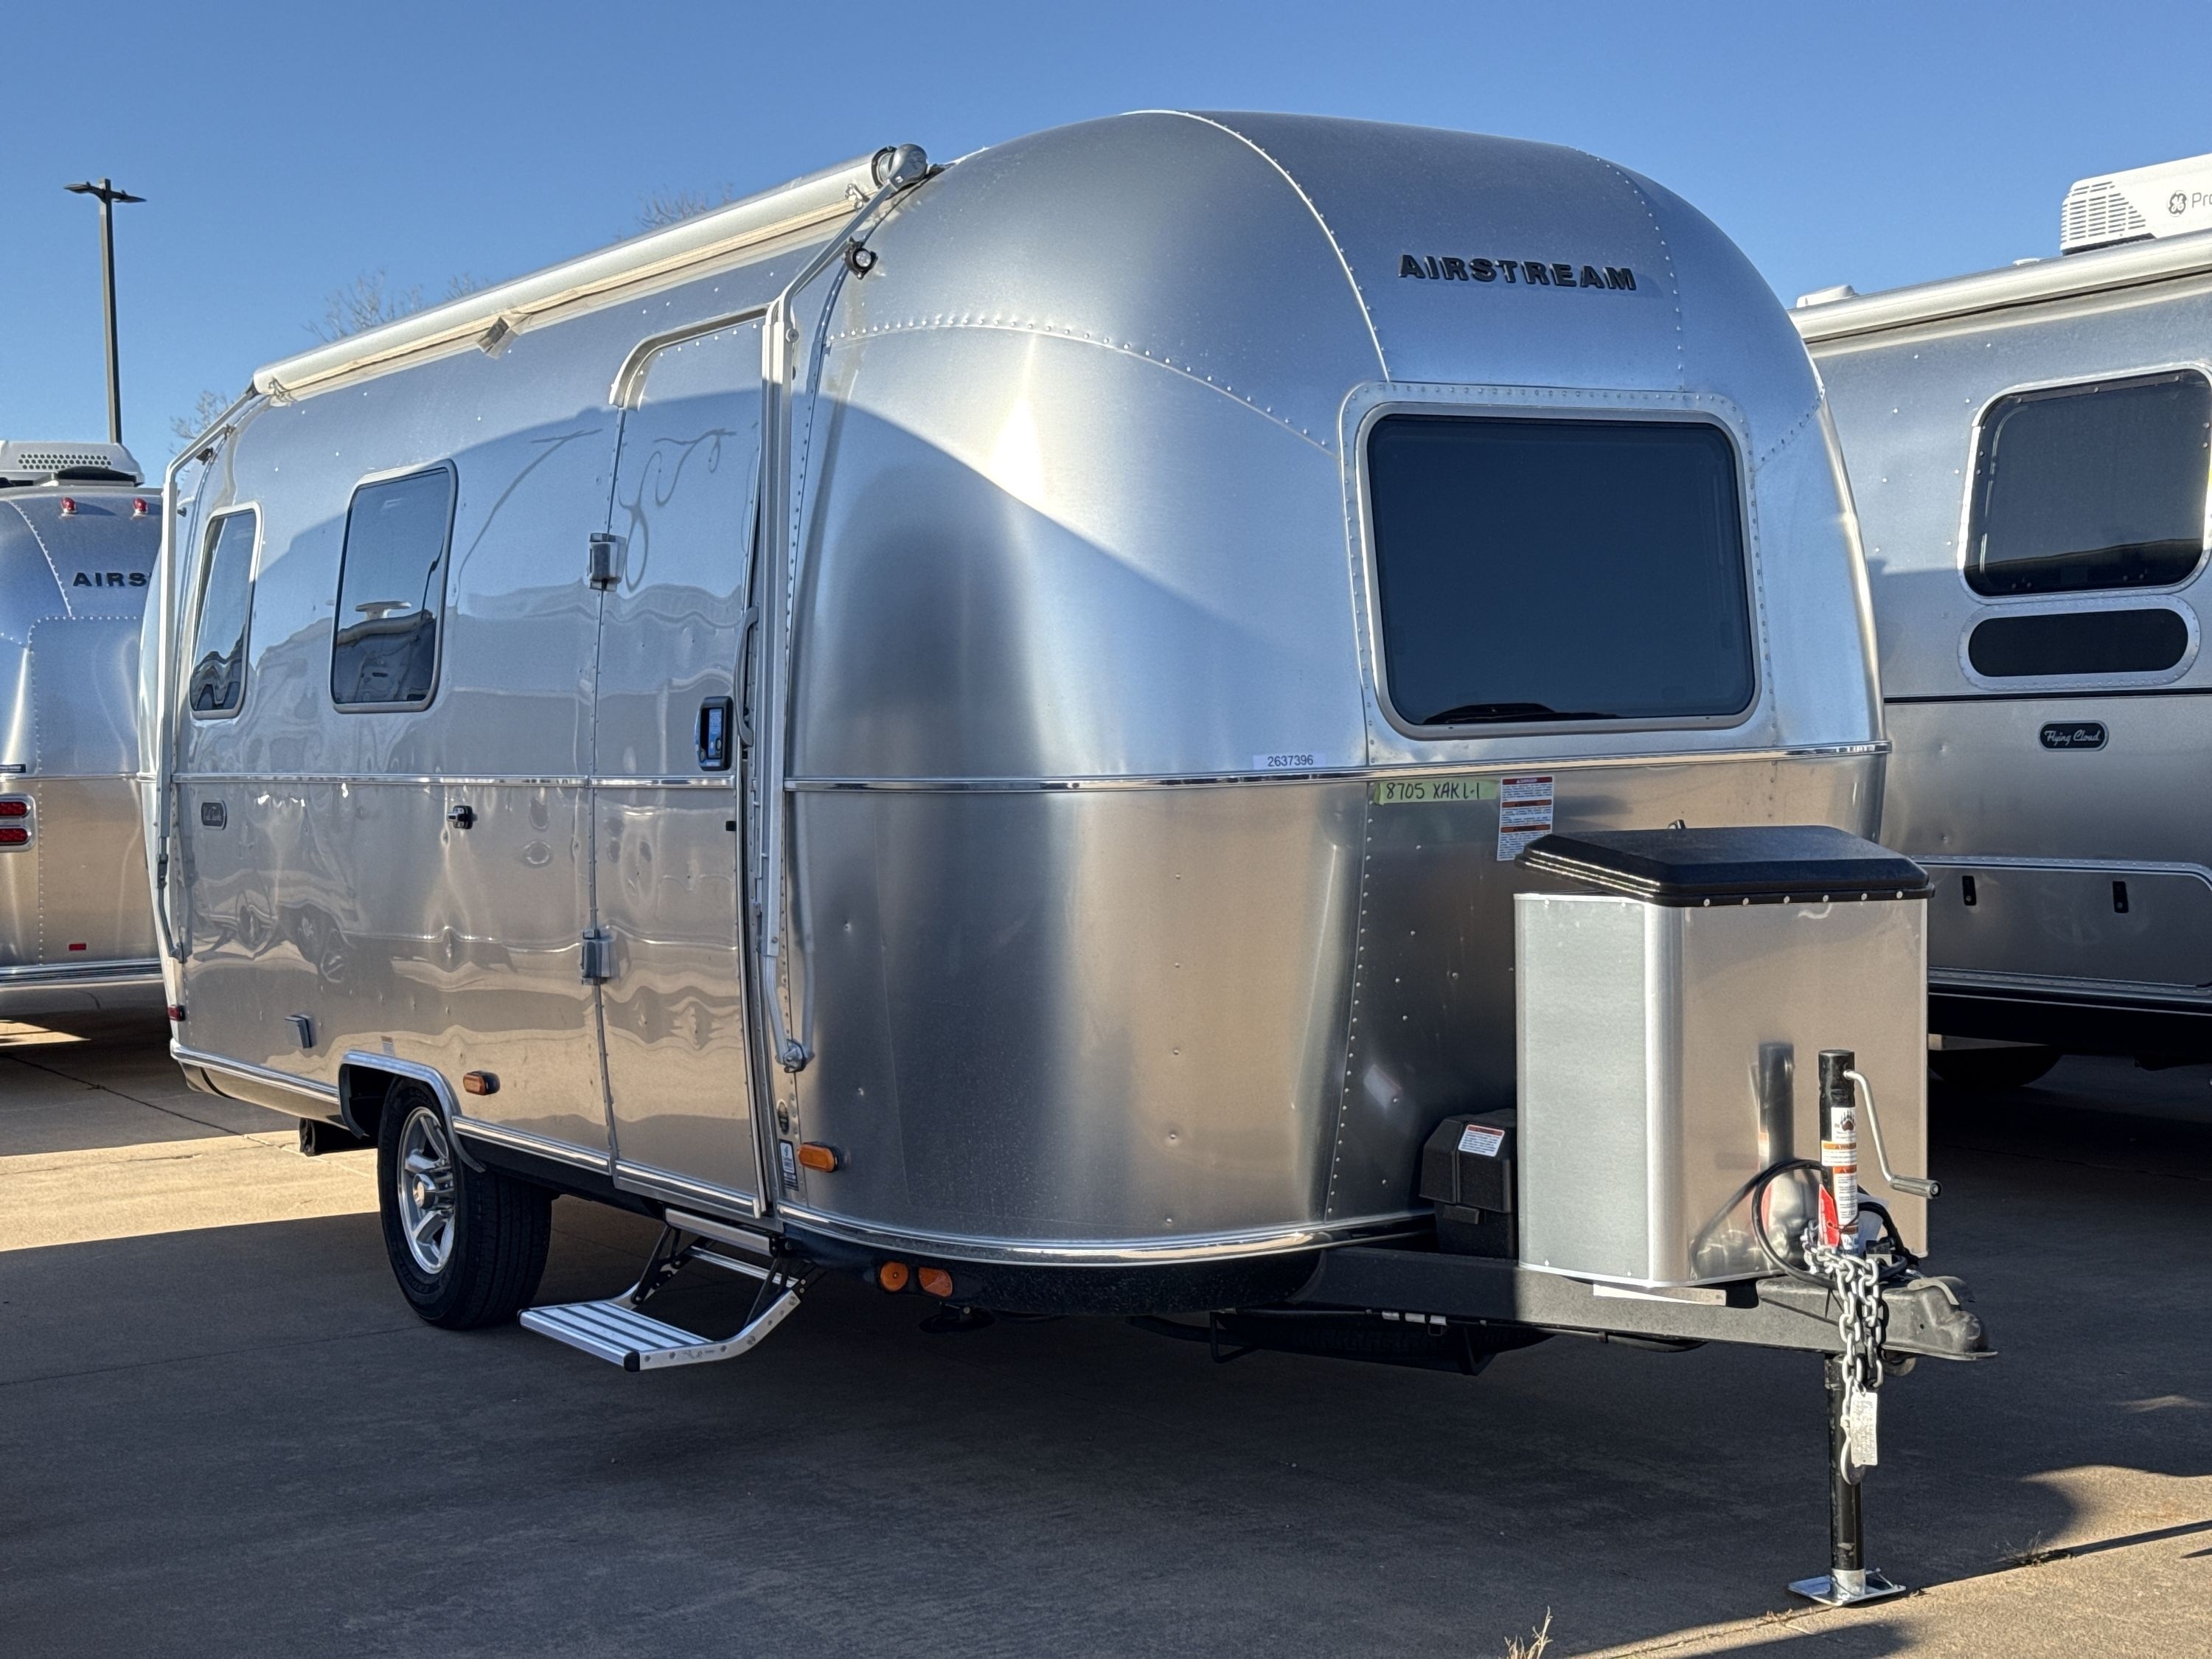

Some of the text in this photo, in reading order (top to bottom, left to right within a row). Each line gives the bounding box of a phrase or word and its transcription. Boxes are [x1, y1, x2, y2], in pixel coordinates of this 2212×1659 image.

[1398, 254, 1637, 291] AIRSTREAM
[73, 572, 152, 587] AIRS
[2044, 729, 2101, 746] Flying Cloud
[1267, 754, 1314, 767] 2637396
[1386, 782, 1425, 800] 8705
